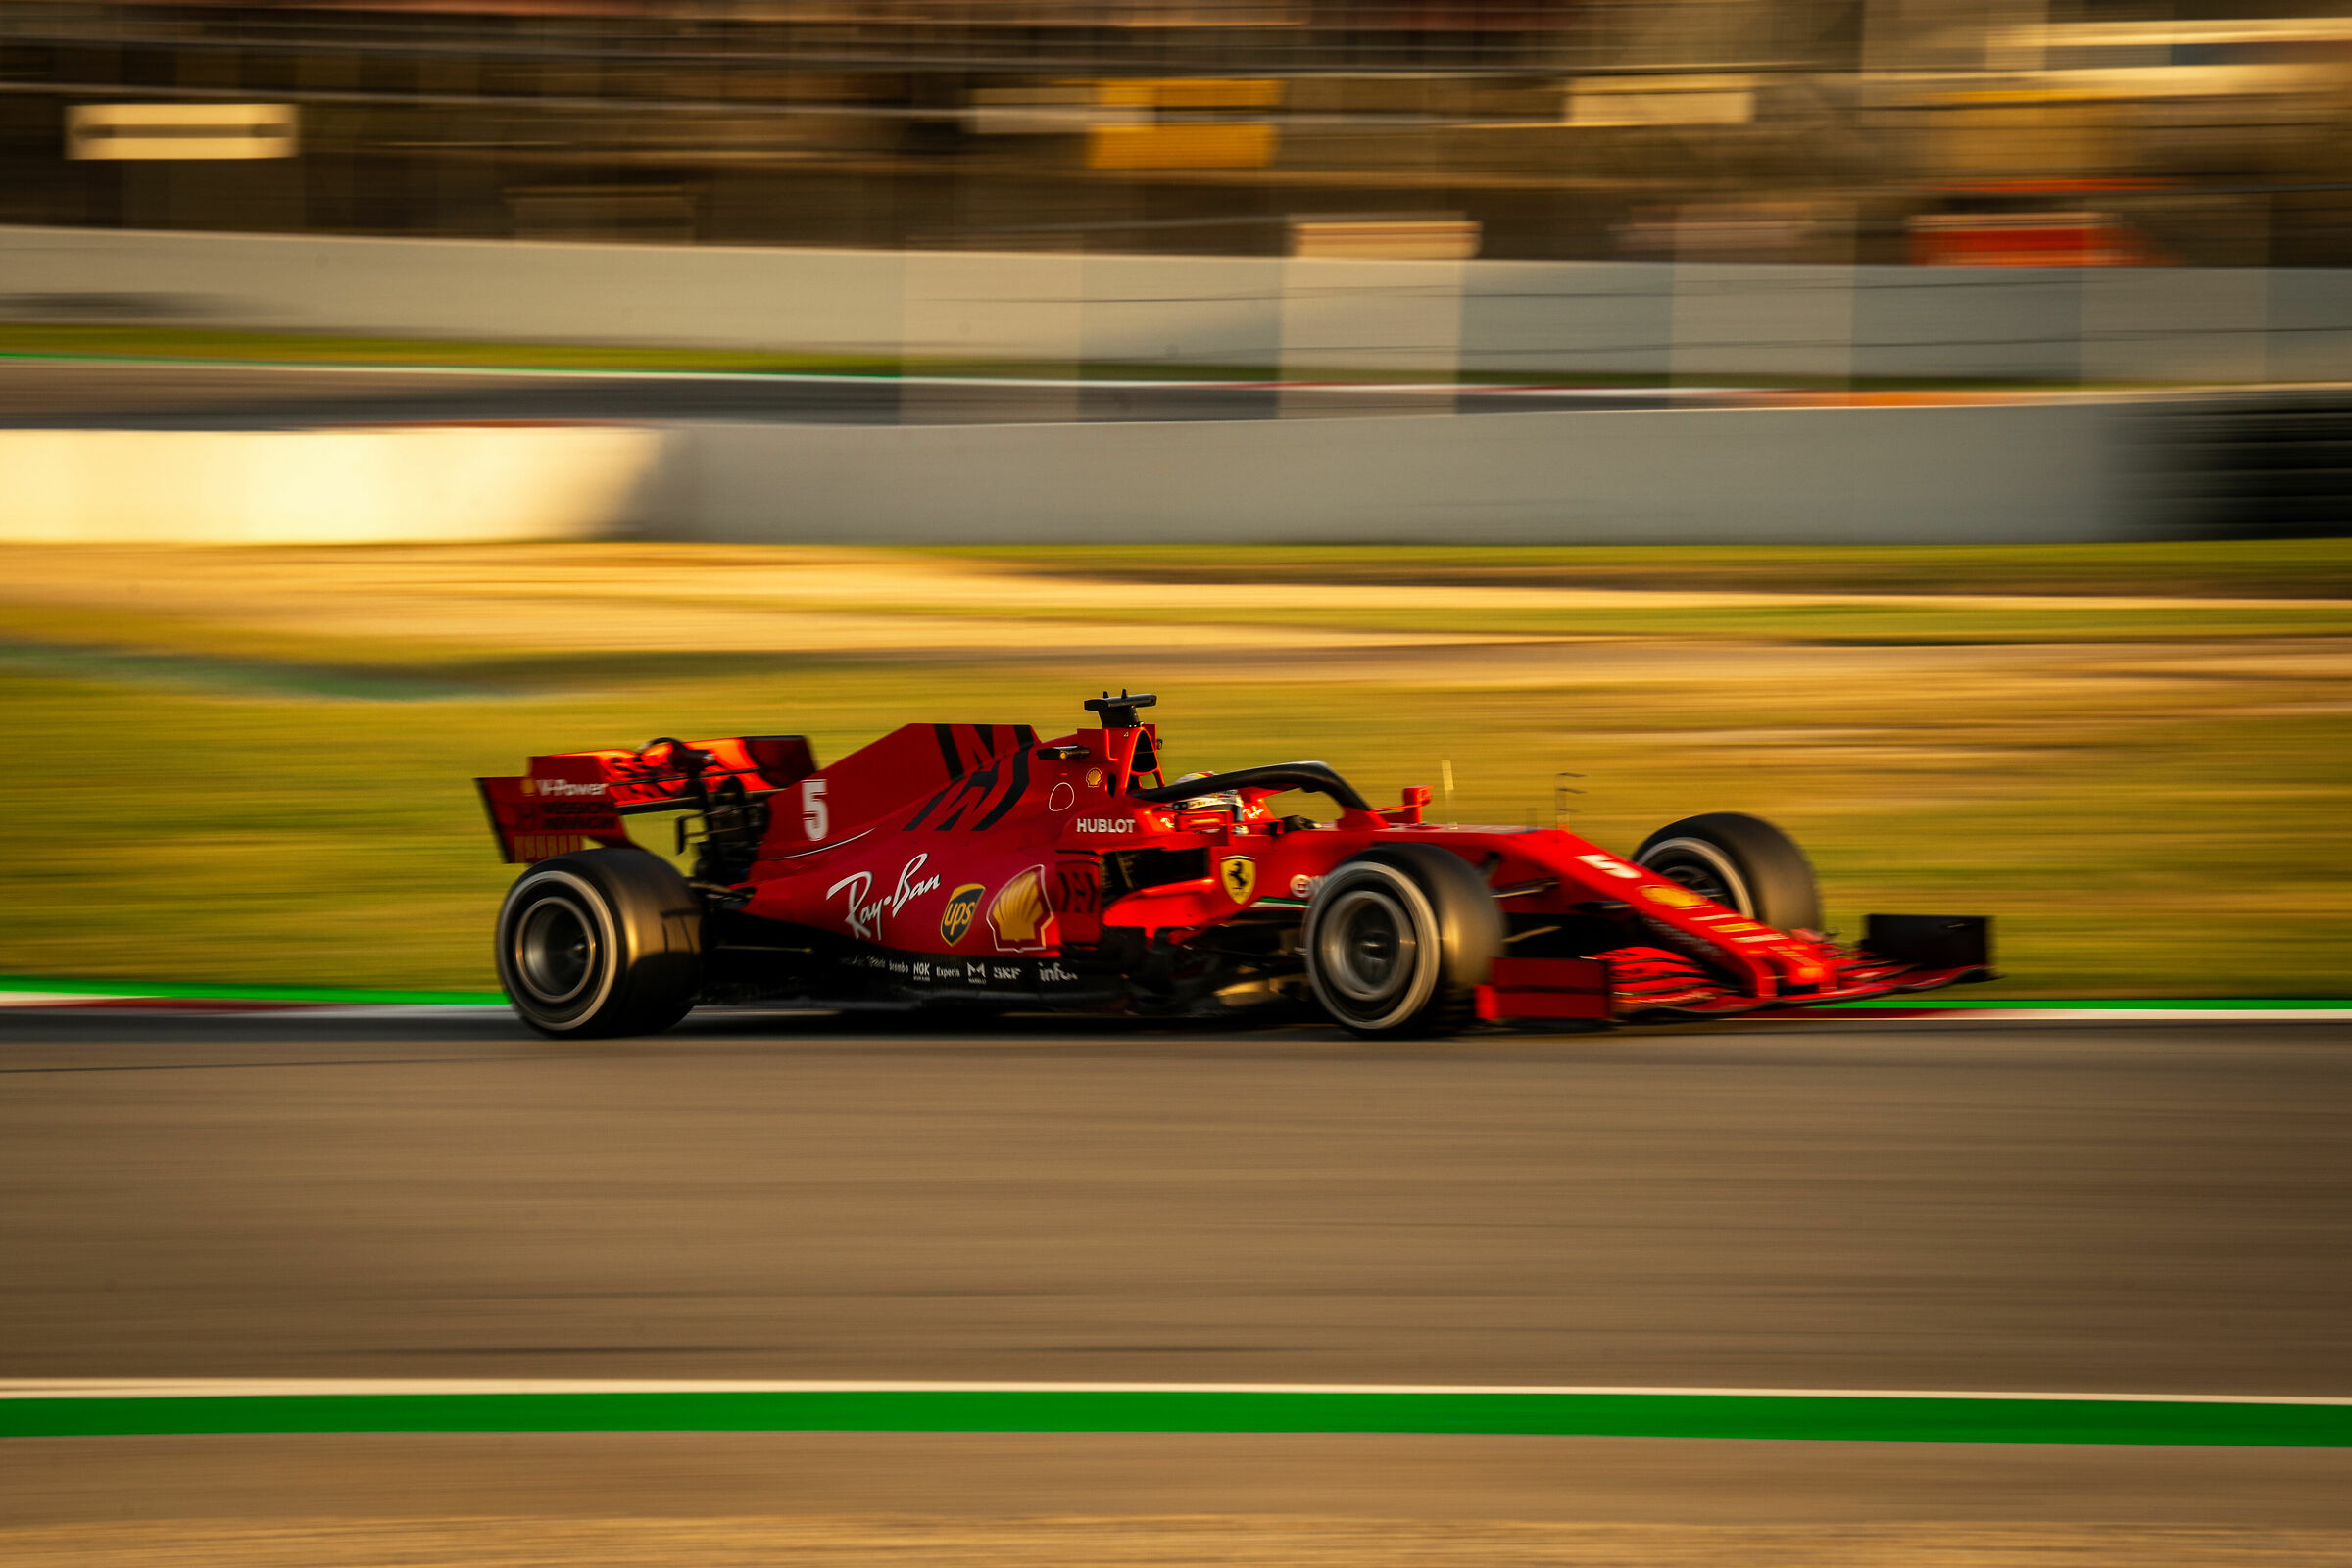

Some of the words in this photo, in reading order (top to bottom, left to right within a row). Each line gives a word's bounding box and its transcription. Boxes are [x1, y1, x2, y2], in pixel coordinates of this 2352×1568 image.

[536, 779, 608, 796] V-Power
[800, 779, 828, 841] 5
[1076, 818, 1136, 833] HUBLOT
[1574, 854, 1643, 879] 5
[944, 900, 975, 936] ups
[913, 962, 930, 976] NGK
[993, 967, 1021, 979] SKF
